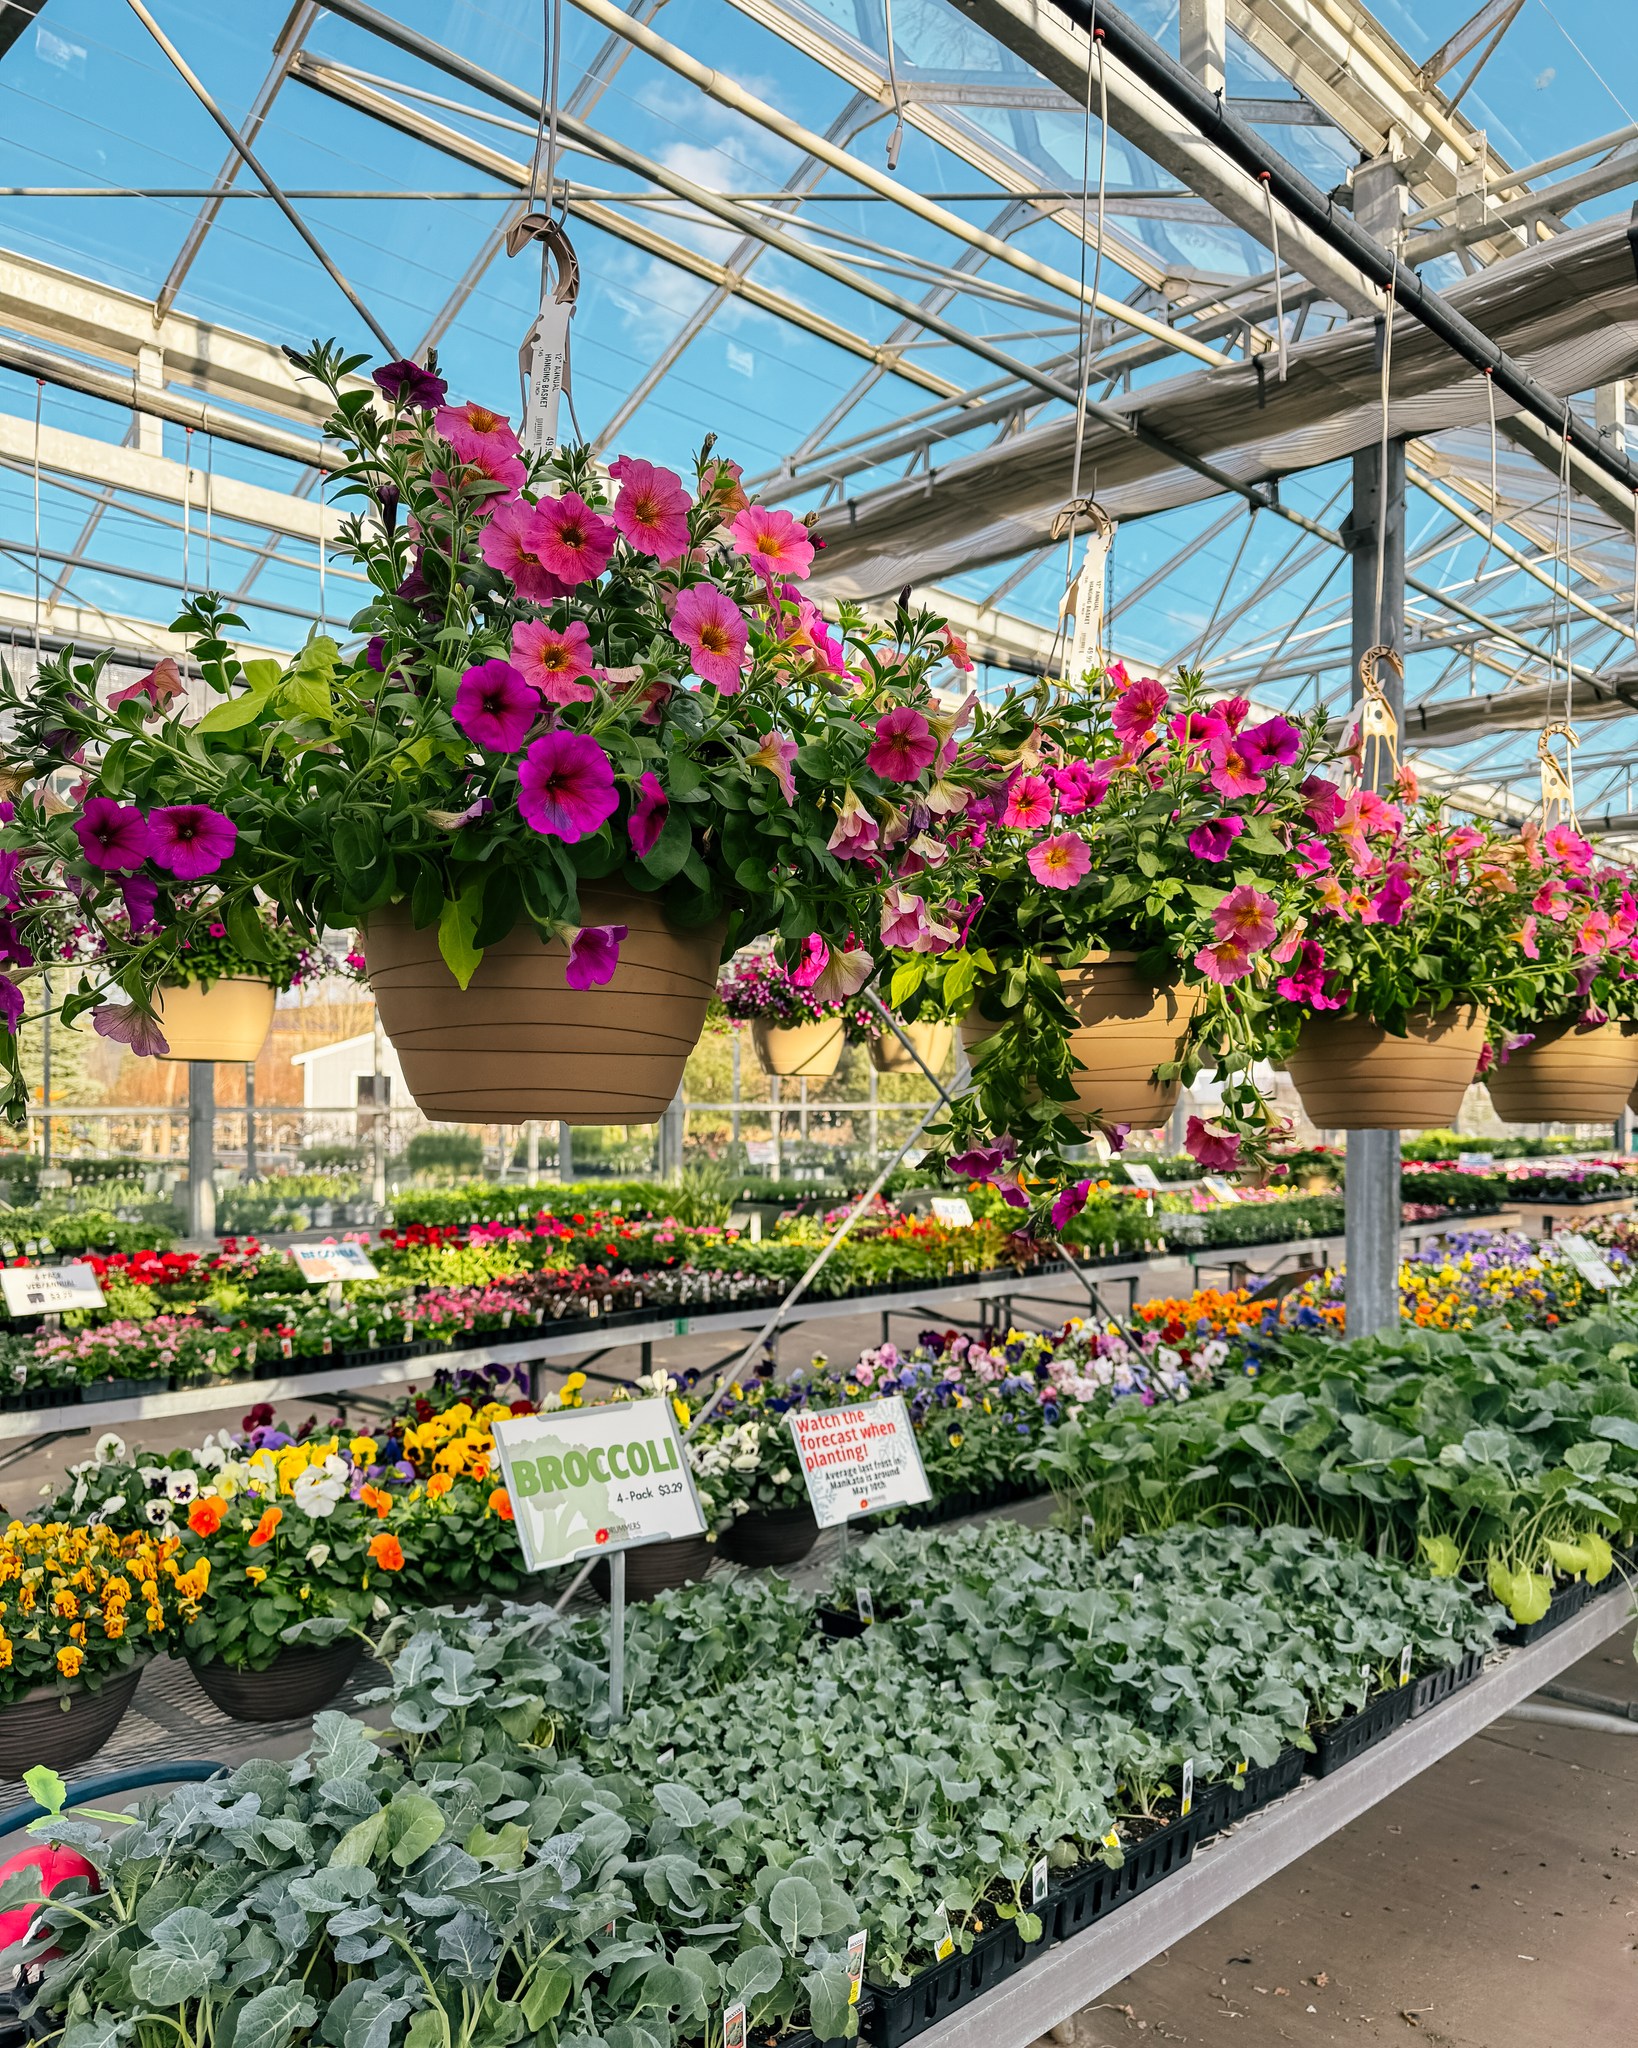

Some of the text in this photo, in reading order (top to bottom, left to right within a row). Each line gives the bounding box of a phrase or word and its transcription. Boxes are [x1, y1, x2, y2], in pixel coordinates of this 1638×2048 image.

[540, 353, 552, 408] HANGING BASKET
[552, 365, 562, 392] ANNUAL
[545, 436, 554, 452] 49.9
[796, 1410, 865, 1433] Watch the
[800, 1421, 896, 1451] forecast when
[511, 1437, 679, 1498] BROCCOLI
[805, 1443, 869, 1472] planting!
[825, 1464, 857, 1481] Average
[858, 1462, 874, 1474] last
[874, 1459, 892, 1471] frost
[829, 1466, 901, 1490] Mankato is around
[658, 1482, 683, 1496] $3.29
[852, 1485, 869, 1496] May
